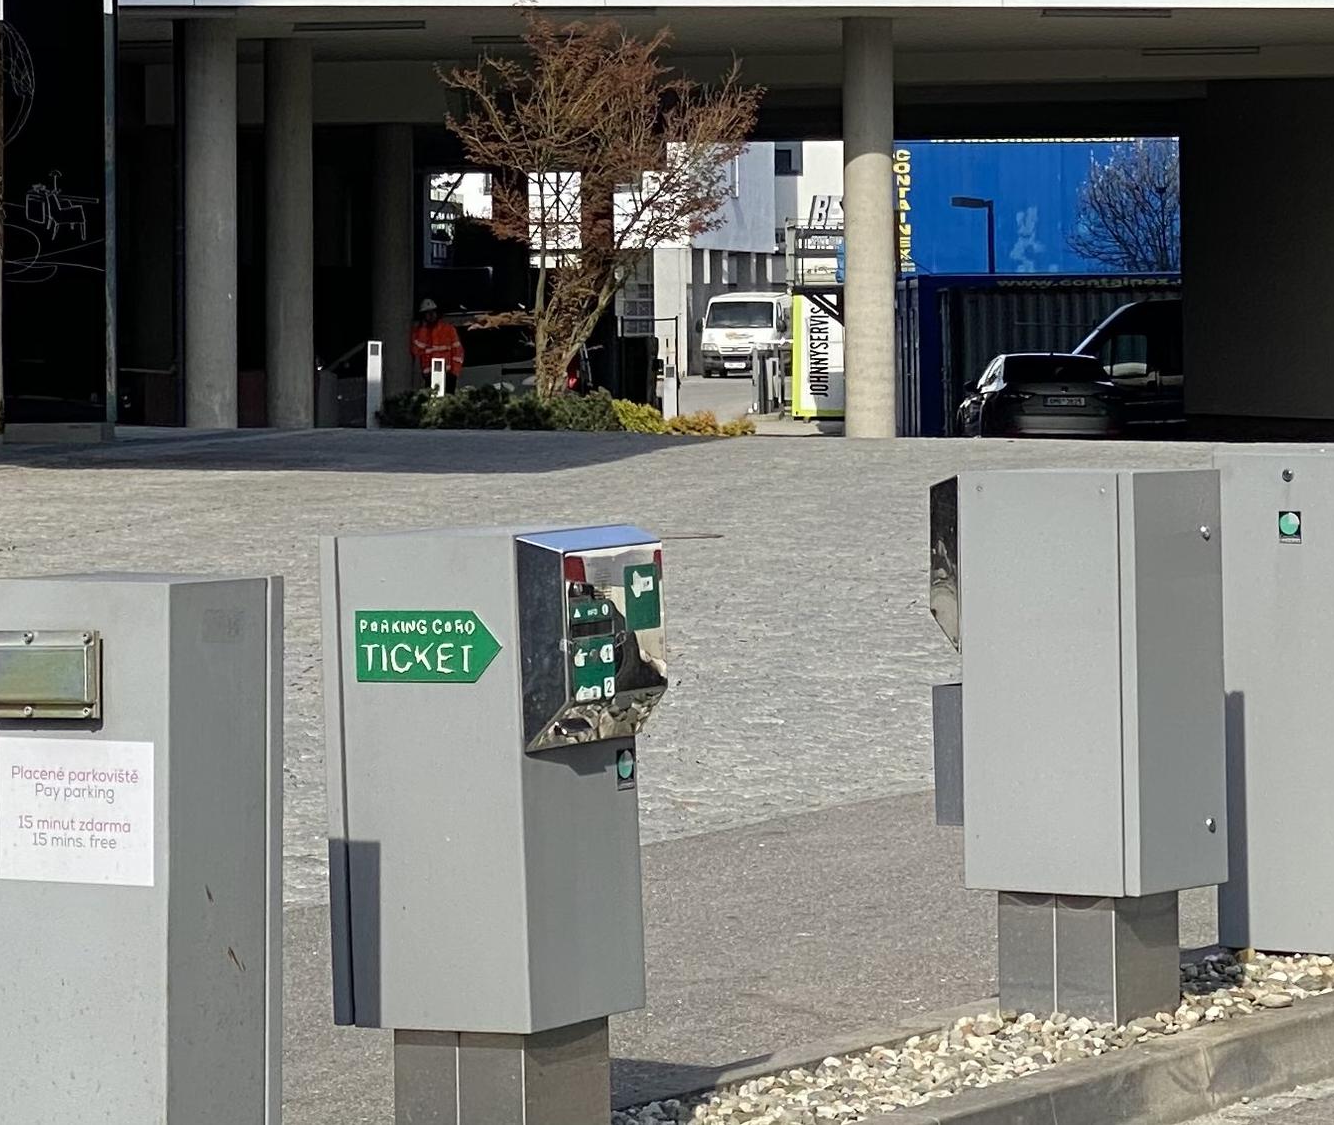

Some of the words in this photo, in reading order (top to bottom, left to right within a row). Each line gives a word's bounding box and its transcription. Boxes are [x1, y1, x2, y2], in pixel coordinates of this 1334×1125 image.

[359, 618, 428, 635] PARKING
[432, 618, 476, 636] CARD
[359, 641, 475, 675] TICKET
[10, 765, 66, 781] Placené
[68, 768, 139, 785] parkoviště
[34, 782, 61, 801] Pay
[63, 784, 116, 805] parking
[18, 814, 33, 829] 15
[36, 818, 76, 831] minut
[78, 818, 132, 833] zdarma
[32, 832, 48, 846] 15
[51, 835, 86, 848] mins.
[89, 834, 118, 849] free
